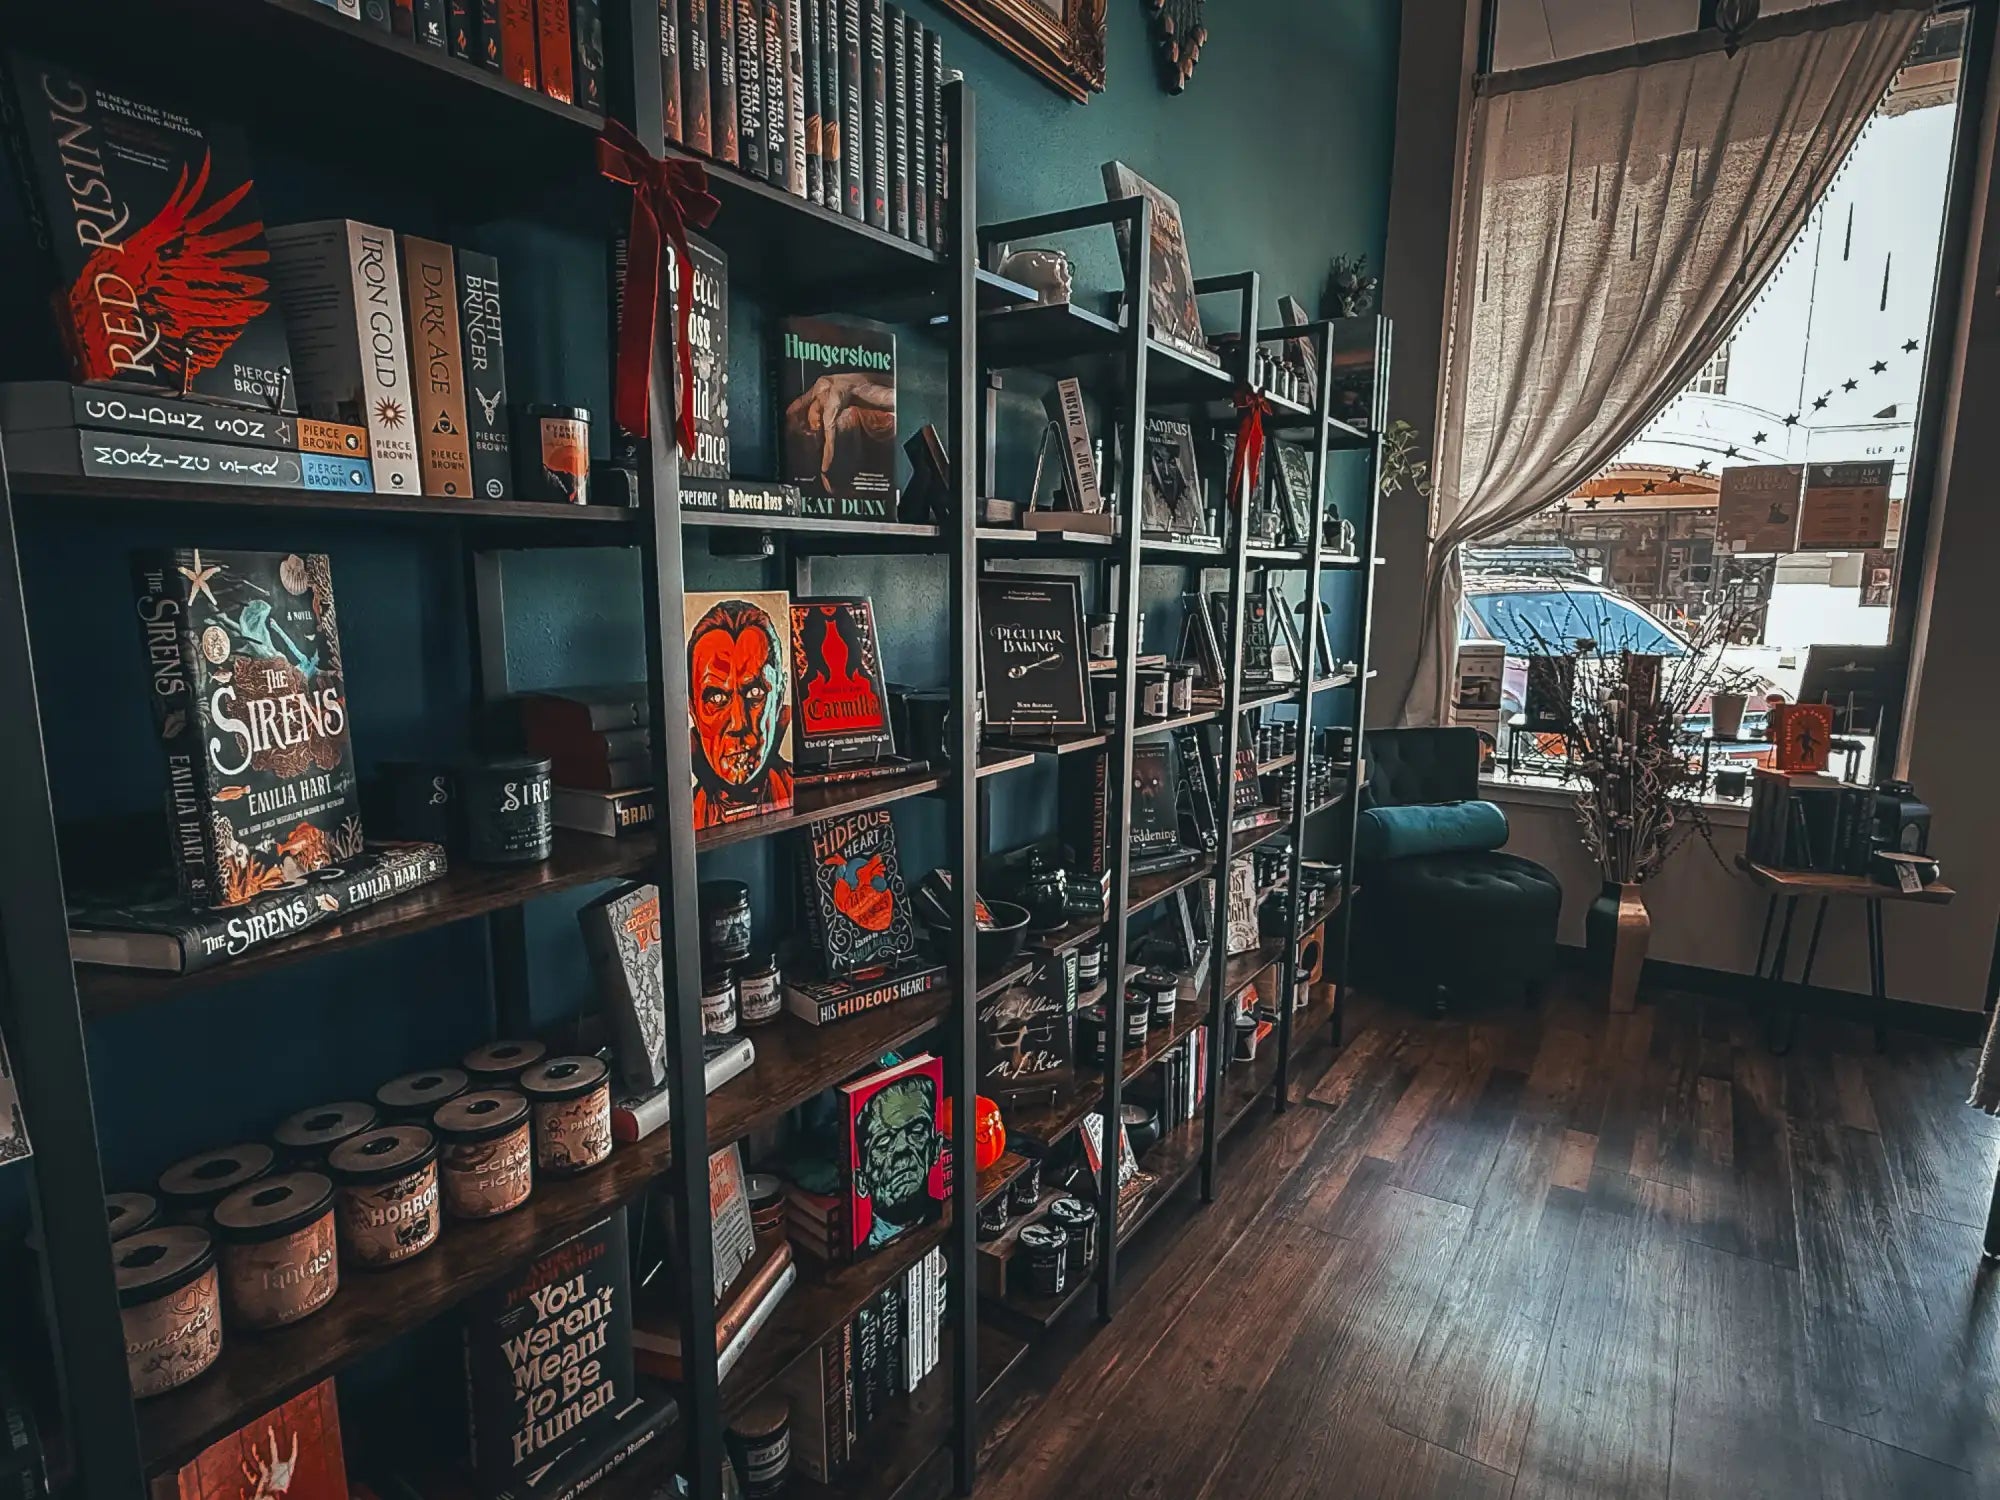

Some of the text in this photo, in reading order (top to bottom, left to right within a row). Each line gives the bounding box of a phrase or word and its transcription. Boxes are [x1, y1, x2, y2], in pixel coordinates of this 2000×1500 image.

[870, 13, 884, 63] DEVILS
[737, 1, 755, 137] HAUNTED HOUSE
[748, 16, 761, 129] HOW TO SELL A
[764, 18, 780, 152] HAUNTED HOUSE
[774, 36, 785, 144] HOW TO SELL A
[97, 98, 161, 126] BESTSELLING
[163, 120, 204, 139] AUTHOR
[162, 109, 190, 126] TIMES
[791, 75, 805, 170] PLAY NICE
[848, 85, 860, 181] JOE ABERCROMBIE
[873, 100, 885, 193] JOE ABERCROMBIE
[42, 72, 161, 377] RED RISING
[358, 234, 398, 388] IRON GOLD
[418, 262, 451, 396] DARK AGE
[463, 273, 488, 370] BRINGER
[482, 277, 504, 347] LIGHT
[687, 310, 711, 351] oss
[784, 332, 892, 371] Hungerstone
[233, 363, 282, 386] PIERCE
[692, 374, 711, 421] ild
[1064, 390, 1082, 427] NOS4A2
[85, 399, 266, 439] GOLDEN SON
[302, 424, 341, 440] PIERCE
[475, 431, 508, 443] PIERCE
[1144, 417, 1188, 437] AMPUS
[94, 442, 280, 477] MORNING STAR
[302, 436, 343, 451] BROWN
[376, 439, 411, 451] PIERCE
[376, 449, 413, 460] BROWN
[431, 448, 465, 461] PIERCE
[475, 441, 509, 452] BROWN
[307, 461, 346, 477] PIERCE
[307, 473, 348, 488] BROWN
[431, 459, 466, 470] BROWN
[1076, 452, 1095, 493] JOE HILL
[679, 488, 783, 511] everence Rebecca Ross
[800, 496, 887, 517] KAT DUNN
[136, 568, 186, 696] THE SIRENS
[287, 609, 313, 621] A NOVEL
[993, 626, 1065, 643] PECULIAR
[1003, 639, 1054, 653] BAKING
[262, 668, 289, 693] THE
[806, 694, 881, 721] Carmilla
[209, 685, 345, 776] SIRENS
[169, 755, 206, 865] EMILIA HART
[247, 773, 333, 817] EMILIA HART
[810, 817, 835, 839] HIS
[812, 810, 891, 858] HIDEOUS
[844, 828, 881, 859] HEART
[1129, 829, 1177, 844] reddening
[202, 862, 423, 957] THE SIRENS EMILIA HART
[820, 976, 927, 1023] HIS HIDEOUS HEART
[1066, 957, 1077, 1012] GHOSTLAND
[1017, 996, 1063, 1018] Villains
[475, 1146, 529, 1175] SCIEN
[479, 1161, 528, 1190] FICTIO
[370, 1181, 438, 1227] HORROR
[529, 1273, 587, 1324] You
[500, 1284, 614, 1369] Weren't
[882, 1304, 891, 1348] KING
[512, 1321, 608, 1401] Meant
[860, 1324, 870, 1372] KING
[561, 1359, 601, 1403] Be
[511, 1379, 617, 1467] Human
[576, 1468, 604, 1495] Meant
[627, 1429, 655, 1457] Human
